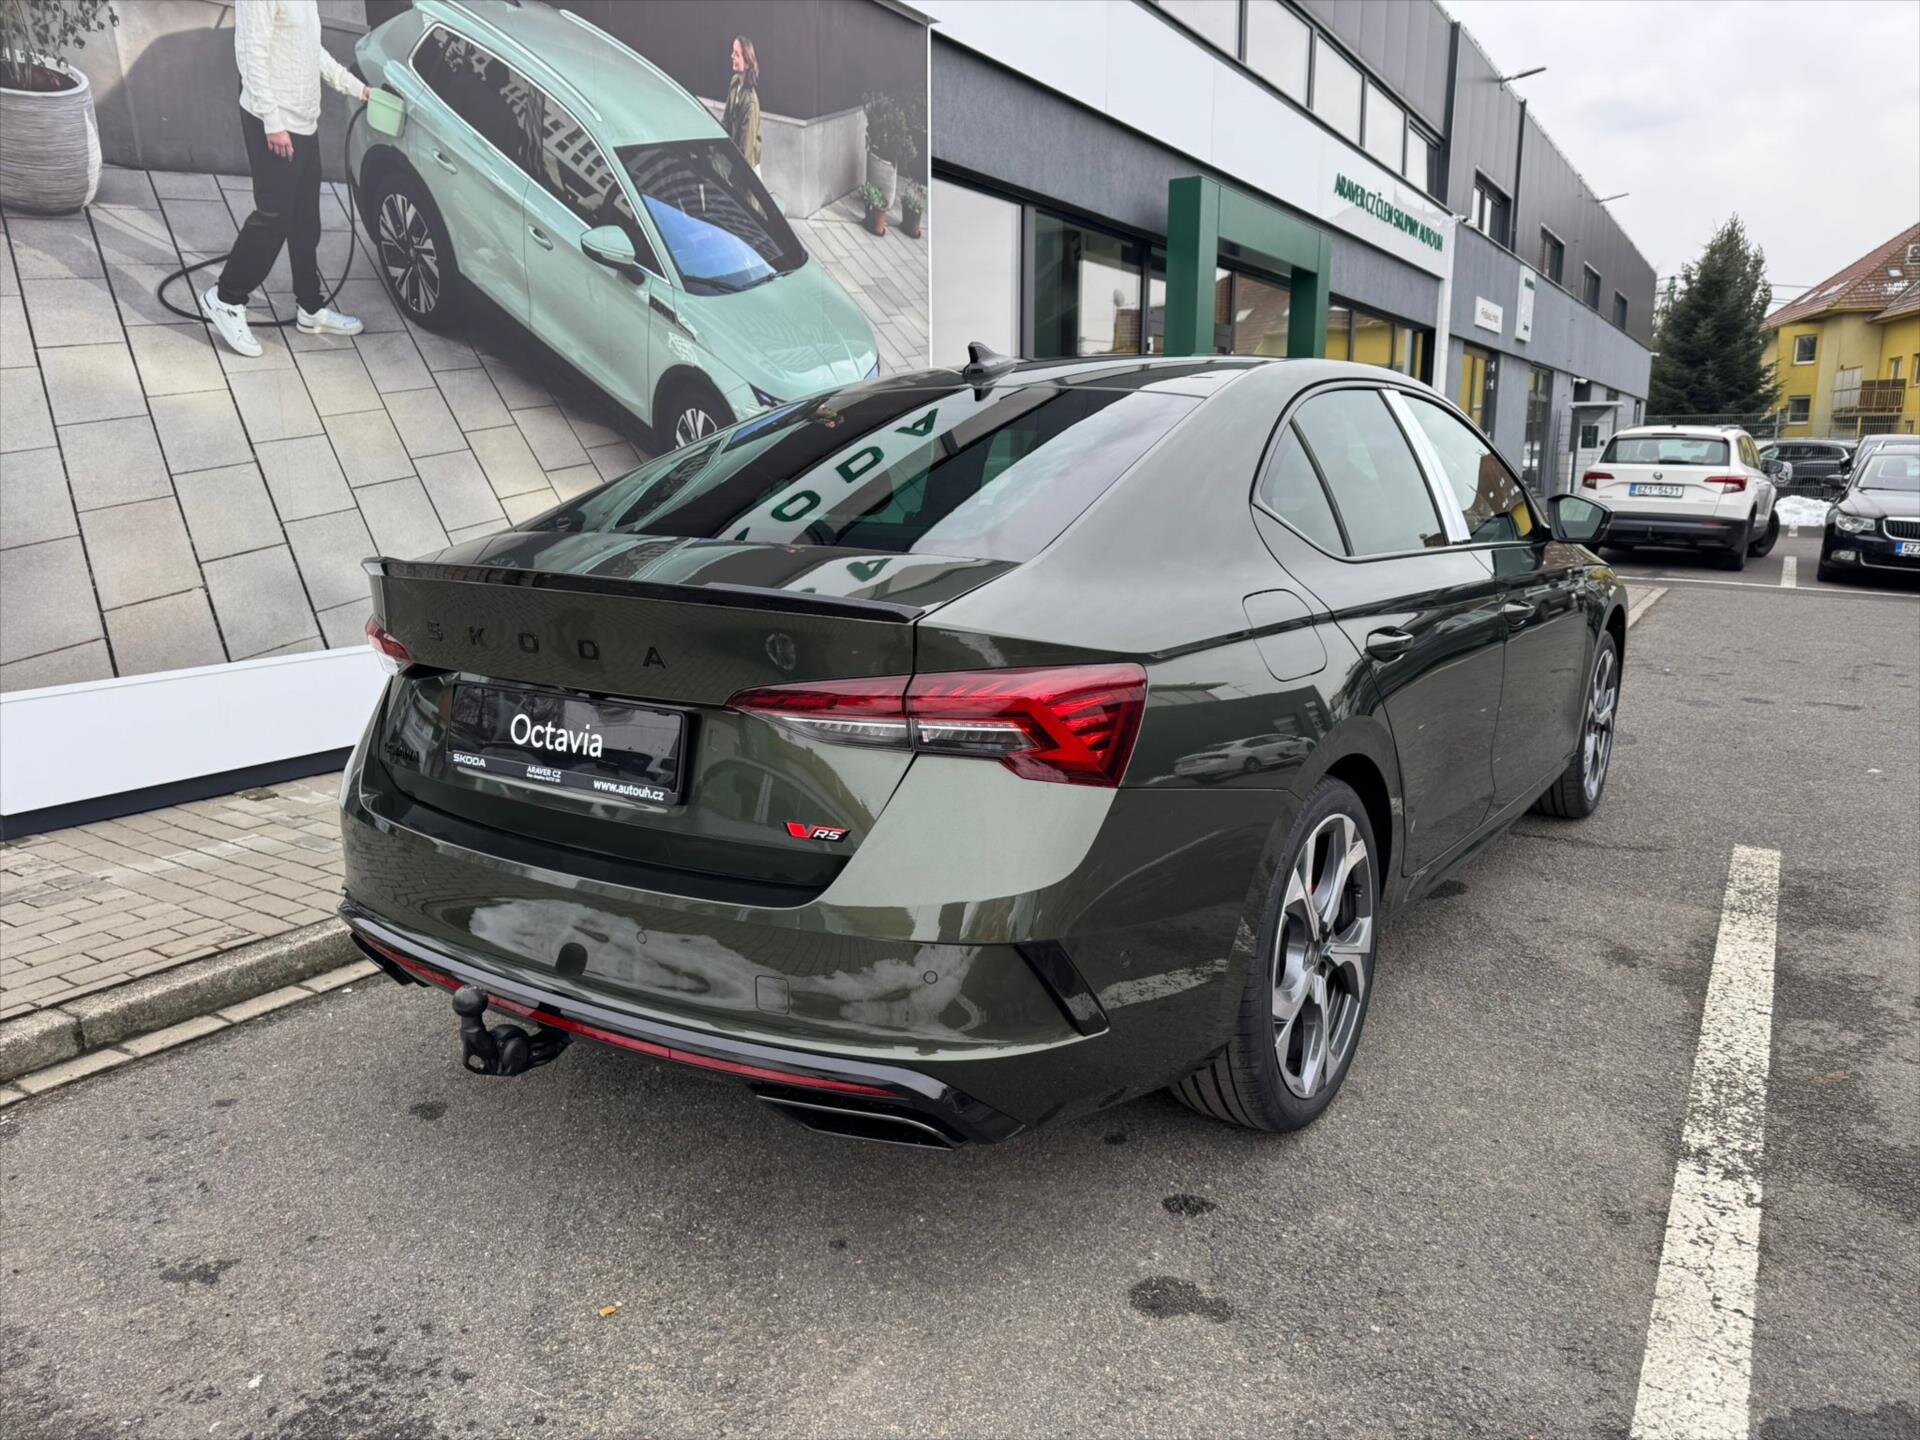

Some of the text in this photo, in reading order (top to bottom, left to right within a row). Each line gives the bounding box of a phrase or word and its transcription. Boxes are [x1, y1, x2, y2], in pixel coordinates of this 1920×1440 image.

[1334, 172, 1366, 209] ARAVER
[1366, 192, 1377, 215] CZ
[510, 713, 603, 758] Octavia
[527, 764, 551, 776] ARAVER
[552, 769, 562, 779] CZ
[593, 779, 664, 801] www.autouh.cz
